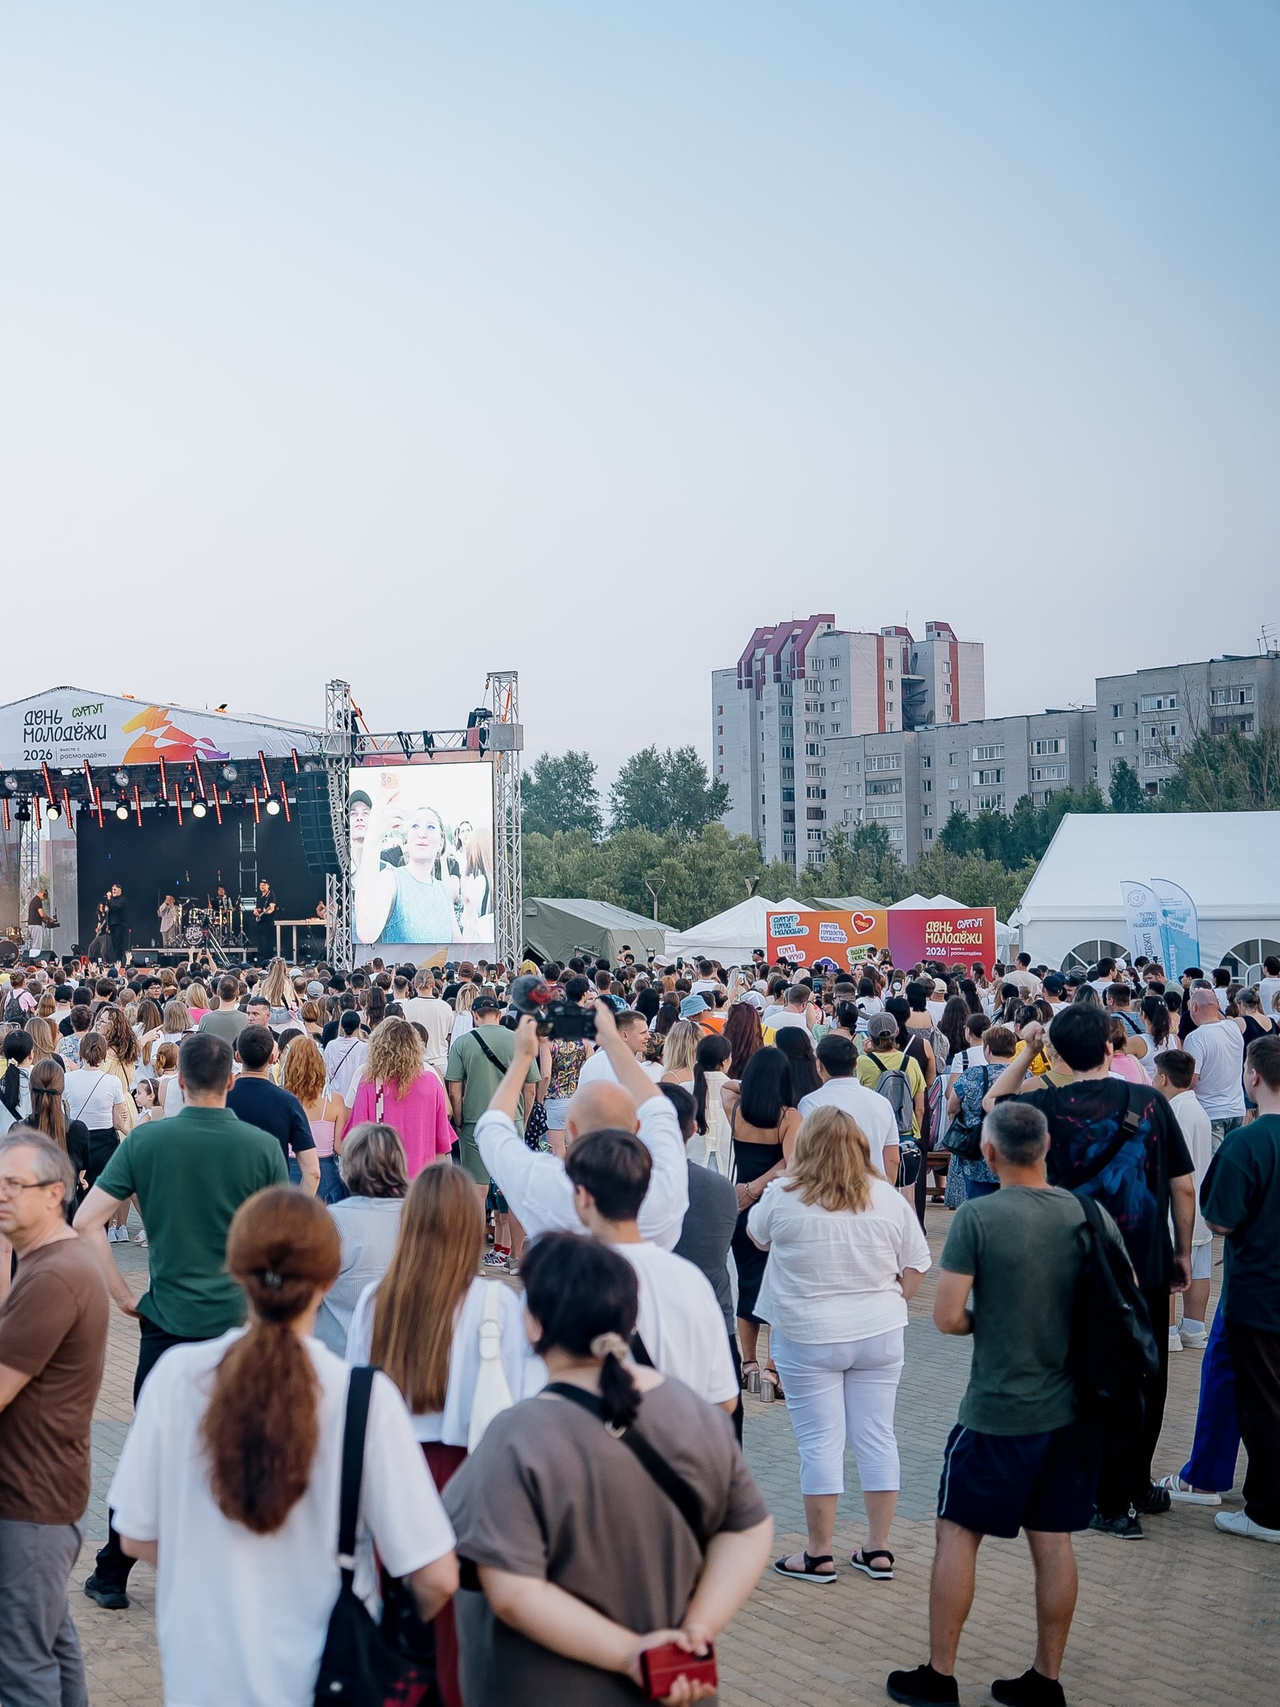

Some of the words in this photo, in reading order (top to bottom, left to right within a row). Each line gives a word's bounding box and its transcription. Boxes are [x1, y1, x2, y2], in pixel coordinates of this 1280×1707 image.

[72, 703, 104, 718] СУРГУТ
[23, 749, 53, 761] 2026
[60, 752, 107, 761] росмолодёжь
[956, 918, 984, 929] СУРГУТ
[778, 946, 795, 955] ГОРИ
[925, 947, 947, 956] 2026
